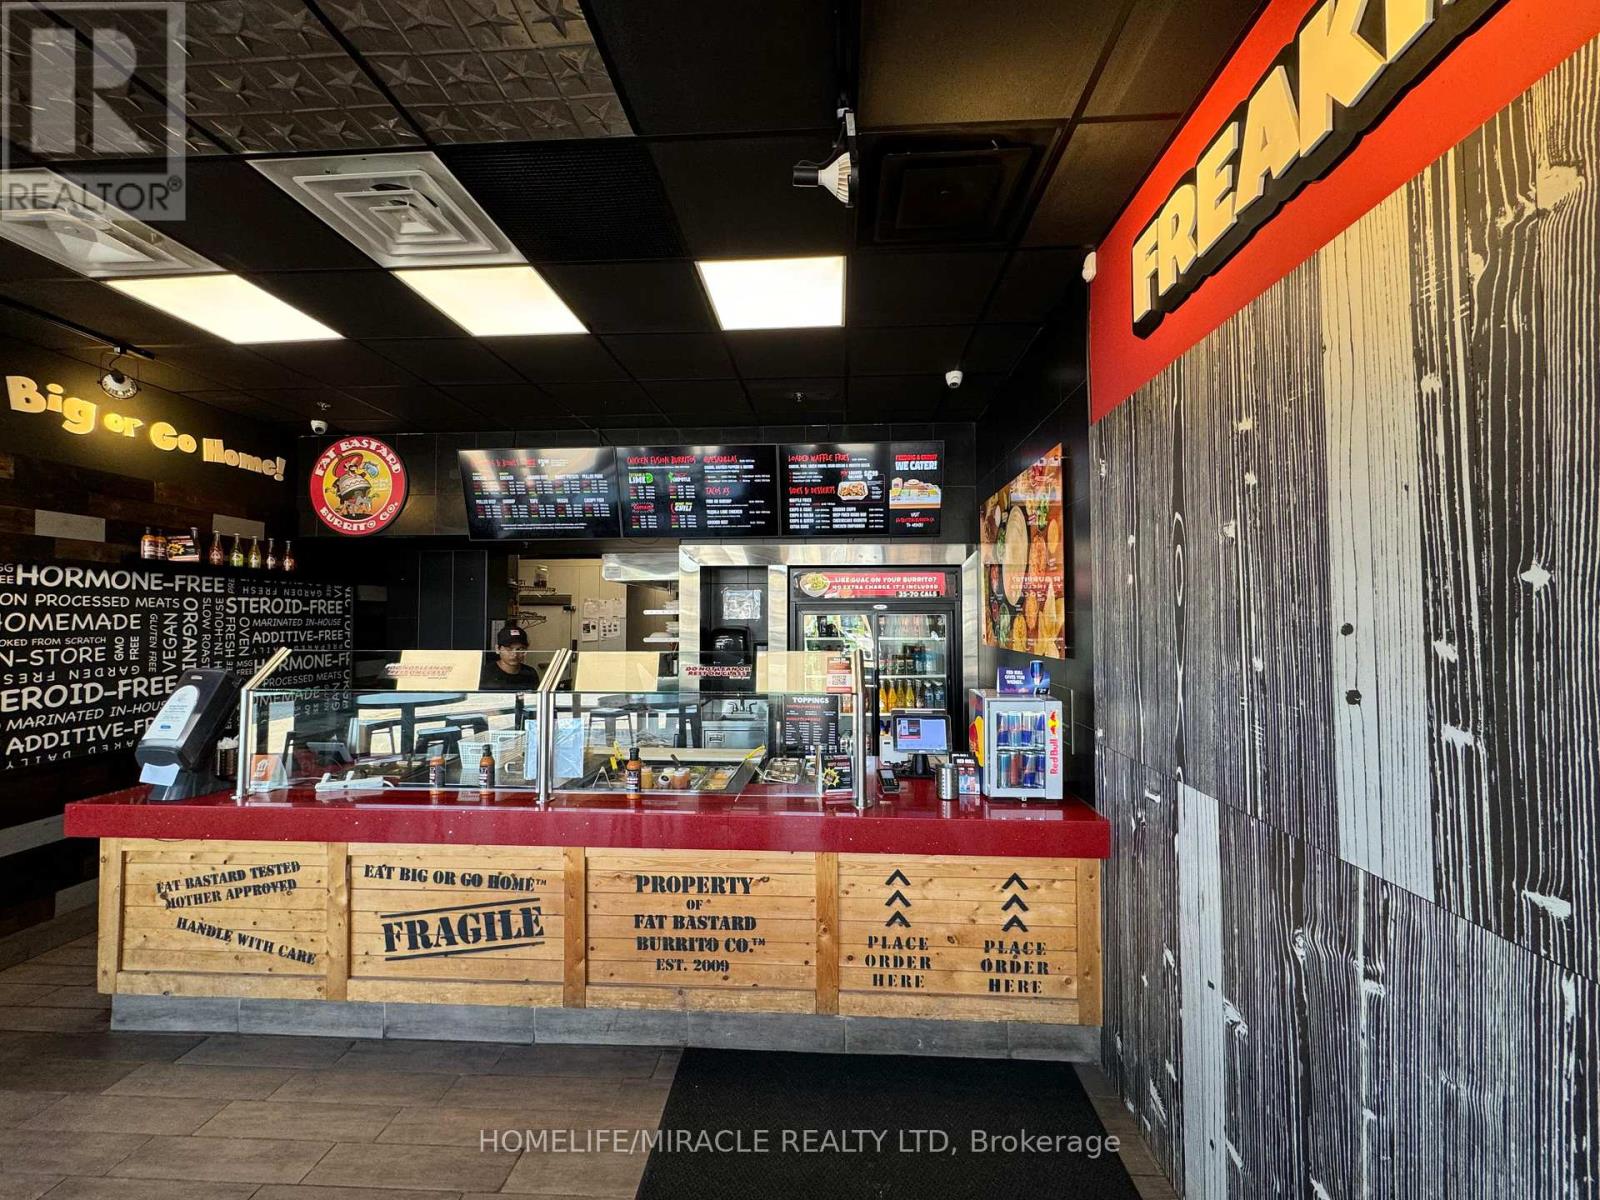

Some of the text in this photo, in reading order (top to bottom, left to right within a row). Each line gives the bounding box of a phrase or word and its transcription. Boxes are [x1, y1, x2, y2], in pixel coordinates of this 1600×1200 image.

[6, 375, 286, 481] Big or Go Home!
[315, 439, 401, 476] FAT BASTARD
[895, 461, 938, 471] WE CATER!
[320, 507, 376, 531] BURRITO
[17, 564, 225, 594] HORMONE-FREE
[35, 593, 130, 607] PROCESSED
[135, 597, 180, 608] MEATS
[226, 597, 343, 614] STEROID-FREE
[0, 612, 141, 632] OMEMADE
[202, 598, 212, 629] SLOW
[252, 618, 341, 627] MARINATED IN-HOUSE
[32, 638, 61, 646] FROM
[65, 636, 107, 645] SCRATCH
[148, 613, 158, 672] GLUTEN FREE
[162, 613, 178, 673] VEGAN
[225, 617, 236, 658] FRESH
[239, 617, 250, 656] OVEN
[252, 630, 343, 644] ADDITIVE-FREE
[69, 666, 140, 680] GARDEN
[792, 696, 829, 704] TOPPINGS
[6, 707, 104, 732] MARINATED
[6, 751, 71, 769] DAILY
[1049, 739, 1059, 775] Red Bull
[156, 861, 301, 894] FAT BASTARD TESTED
[364, 864, 395, 880] EAT
[400, 867, 428, 883] BIG
[433, 870, 456, 885] OR
[460, 872, 483, 887] GO
[635, 875, 754, 894] PROPERTY
[165, 878, 297, 910] MOTHER APPROVED
[686, 900, 704, 910] OF
[382, 906, 544, 952] FRAGILE
[634, 914, 756, 930] FAT BASTARD
[176, 917, 317, 965] HANDLE WITH CARE
[636, 936, 719, 952] BURRITO
[867, 936, 929, 951] PLACE
[984, 940, 1046, 955] PLACE
[656, 958, 729, 972] EST. 2009
[864, 955, 932, 970] ORDER
[980, 959, 1049, 975] ORDER
[872, 974, 925, 988] HERE
[988, 978, 1042, 993] HERE
